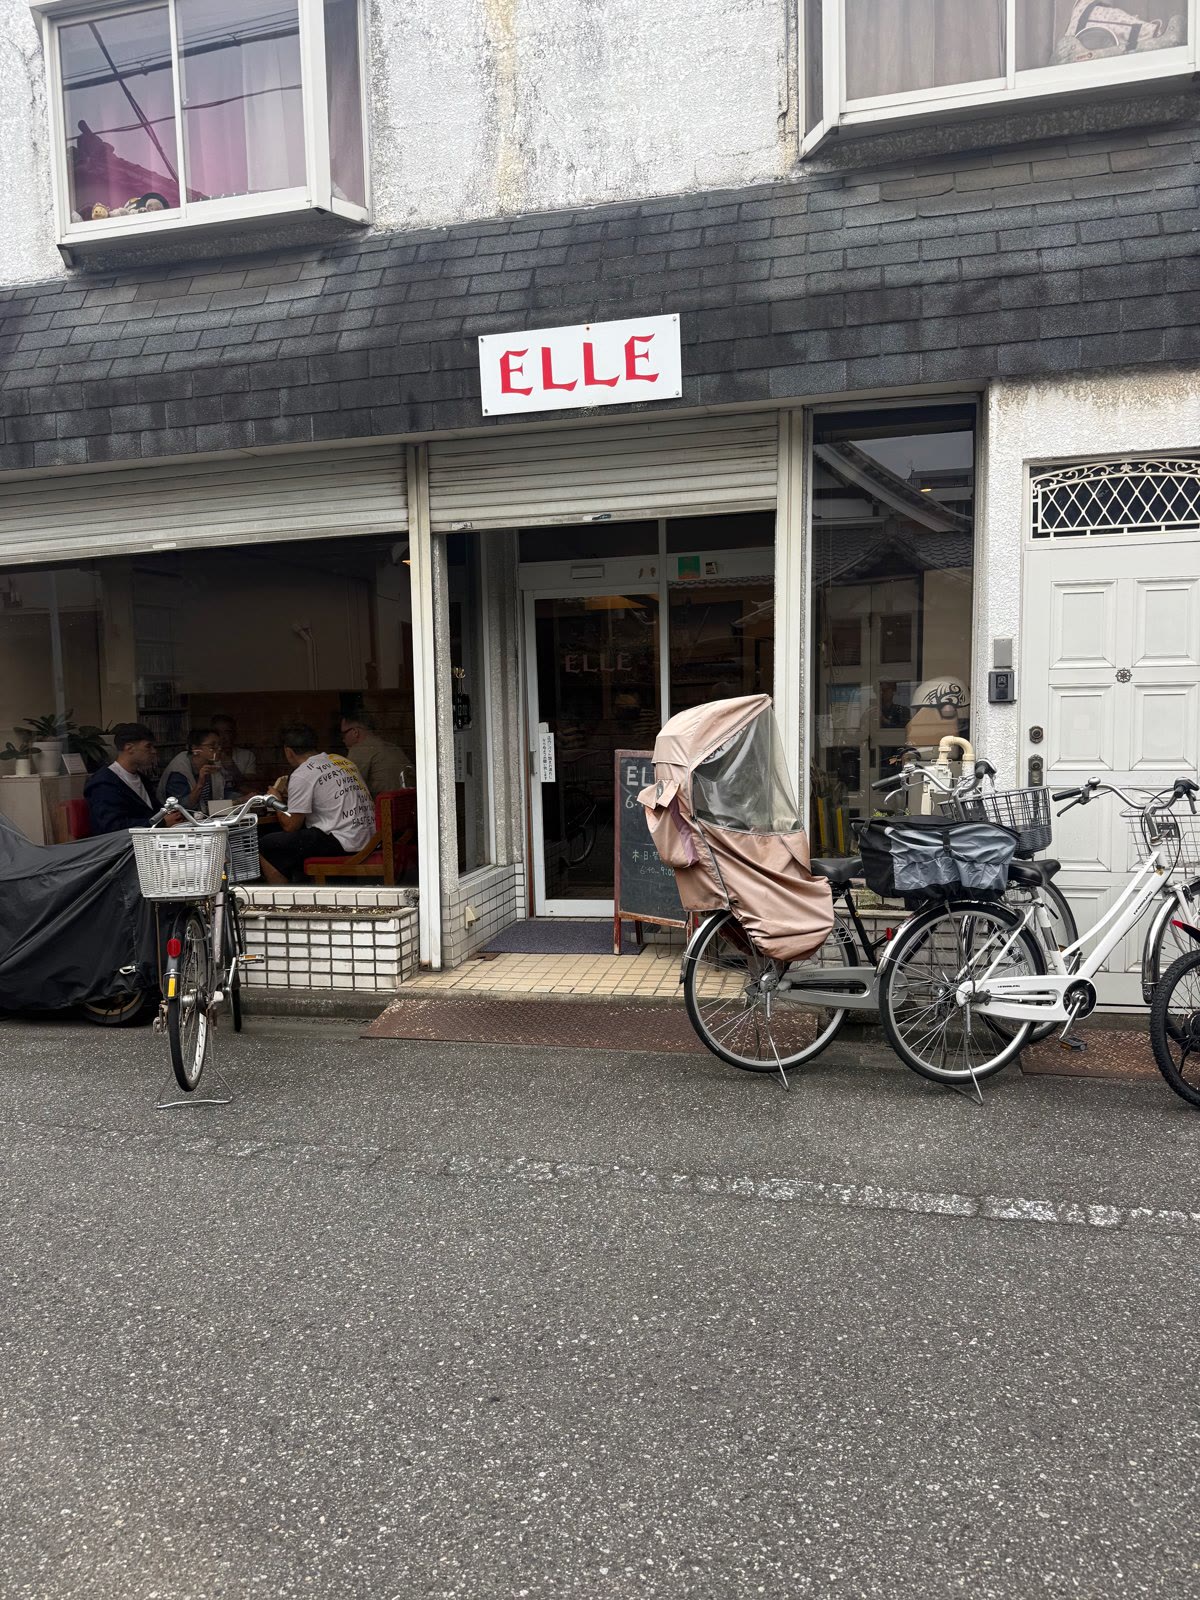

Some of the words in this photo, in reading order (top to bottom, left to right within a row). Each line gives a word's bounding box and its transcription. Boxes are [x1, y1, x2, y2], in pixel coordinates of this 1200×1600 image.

[500, 333, 660, 396] ELLE
[307, 762, 315, 770] IF
[316, 764, 331, 773] YOU
[335, 775, 357, 787] UNDER
[626, 766, 653, 786] EL
[342, 808, 358, 819] NOT
